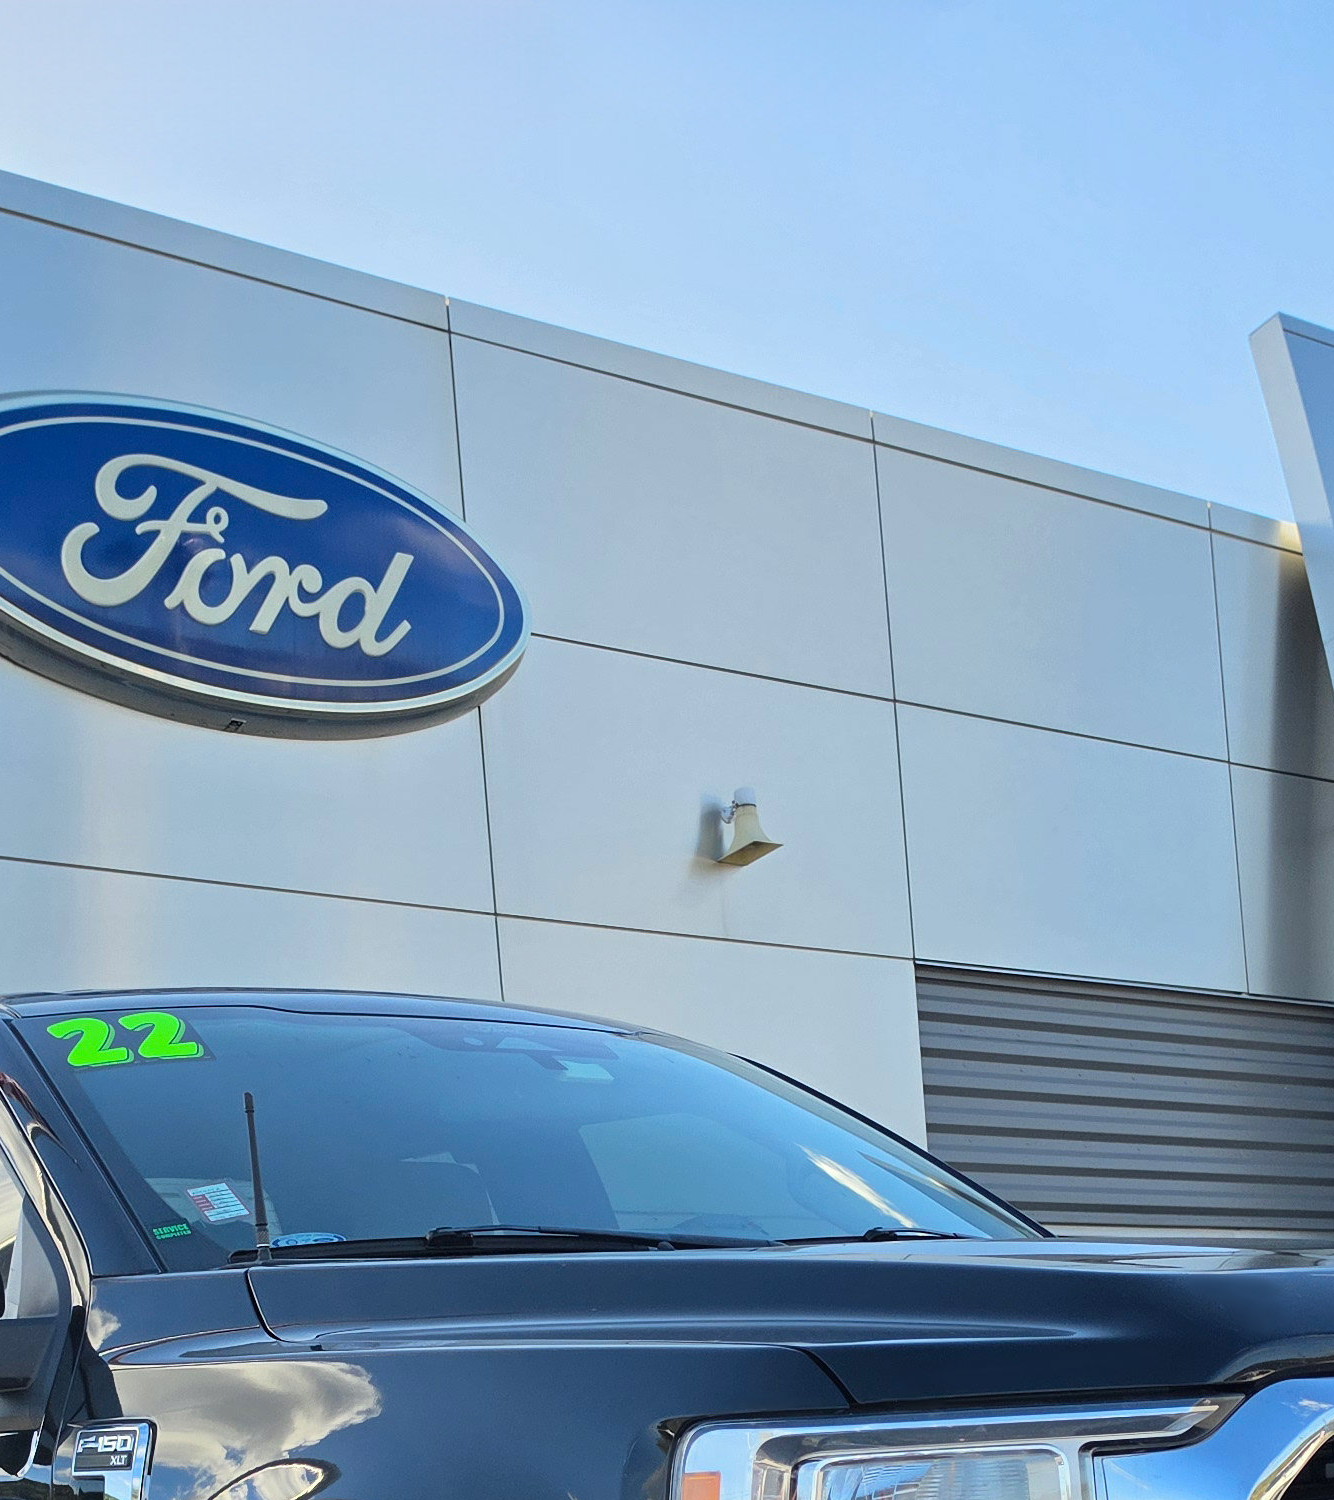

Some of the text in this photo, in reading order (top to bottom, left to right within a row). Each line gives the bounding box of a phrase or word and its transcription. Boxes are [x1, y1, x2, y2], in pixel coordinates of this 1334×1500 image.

[61, 453, 414, 657] Ford
[46, 1012, 205, 1067] 22
[77, 1435, 133, 1453] F-150
[110, 1455, 127, 1465] XLT
